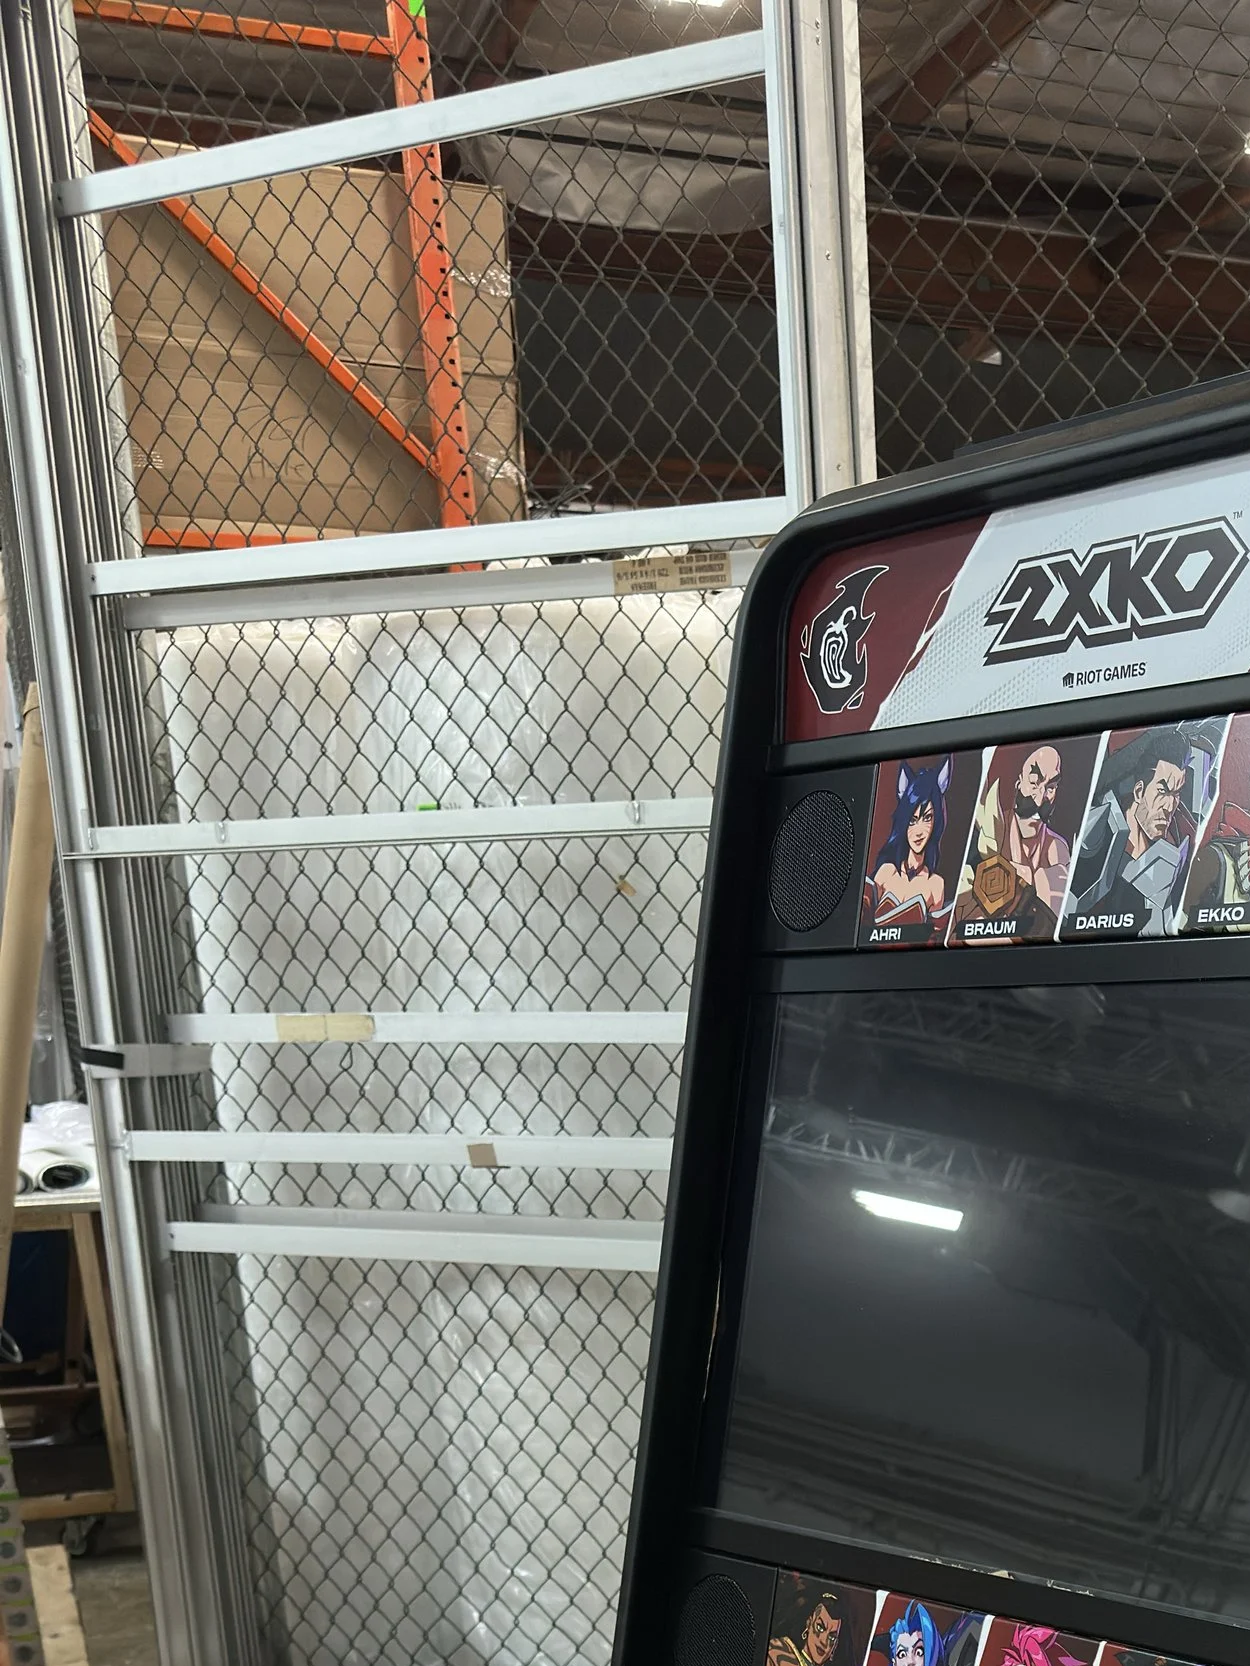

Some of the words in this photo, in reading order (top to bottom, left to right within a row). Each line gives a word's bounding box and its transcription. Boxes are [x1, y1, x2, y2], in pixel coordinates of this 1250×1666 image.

[984, 516, 1250, 666] 2XKO
[1076, 669, 1102, 687] RIOT
[1103, 662, 1147, 681] GAMES
[1075, 913, 1135, 930] DARIUS
[1198, 906, 1245, 923] EKKO
[869, 928, 902, 942] AHRI
[964, 921, 1017, 936] BRAUM
